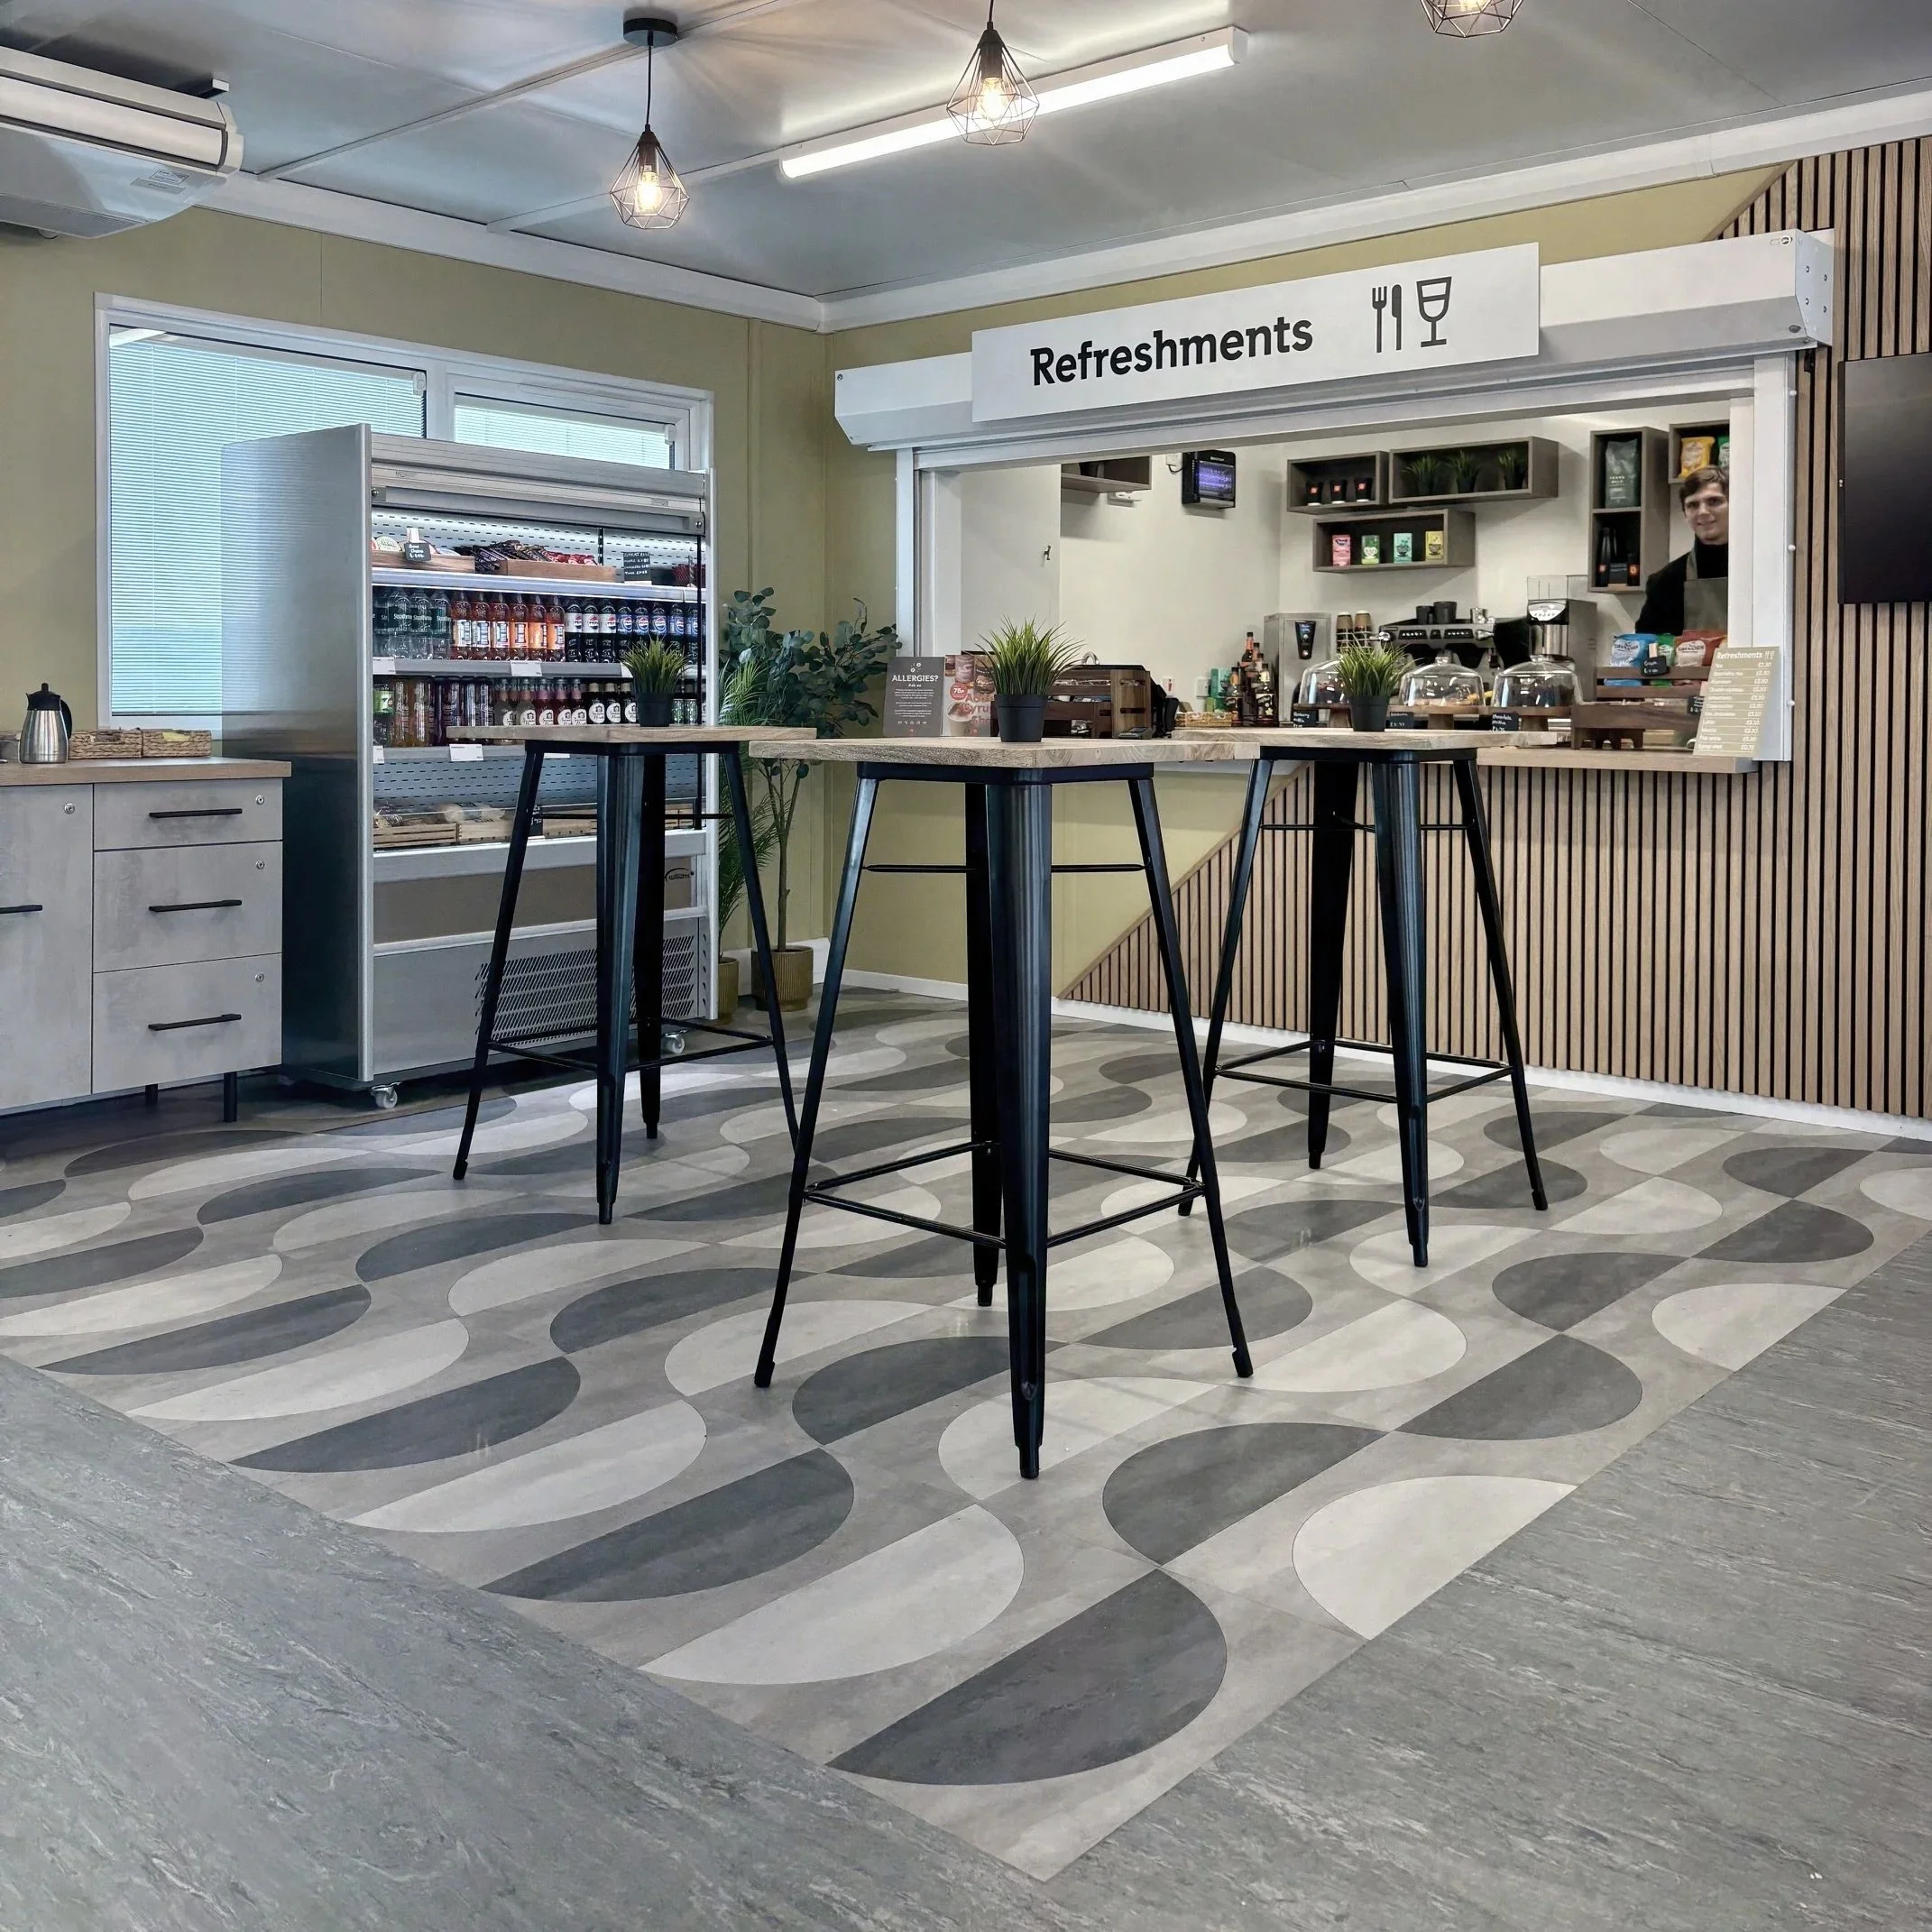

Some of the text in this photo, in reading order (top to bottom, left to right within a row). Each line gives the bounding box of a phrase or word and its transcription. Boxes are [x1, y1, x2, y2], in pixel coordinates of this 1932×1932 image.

[1030, 316, 1313, 386] Refreshments
[1716, 651, 1762, 659] Refreshments
[964, 703, 989, 714] Syru
